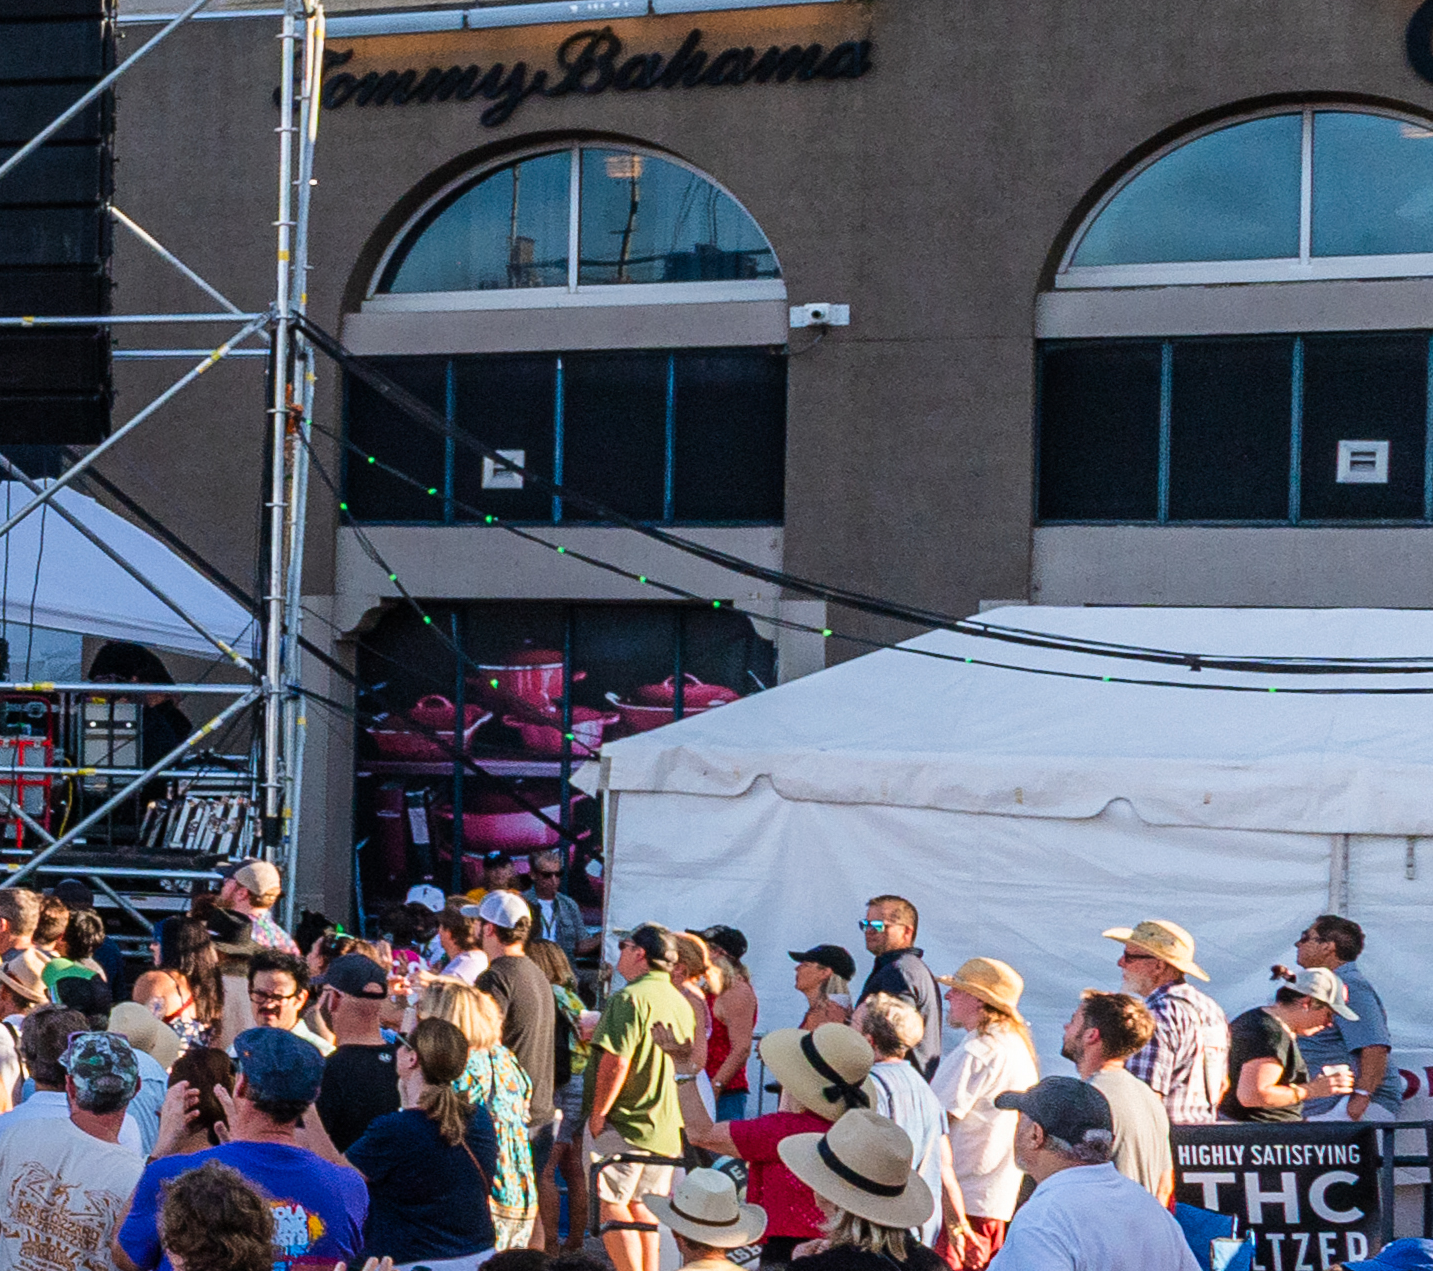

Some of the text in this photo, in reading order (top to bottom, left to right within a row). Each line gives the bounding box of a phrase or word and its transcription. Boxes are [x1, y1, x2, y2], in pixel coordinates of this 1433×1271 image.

[540, 27, 874, 98] Bahama
[1178, 1144, 1361, 1166] HIGHLY SATISFYING
[1182, 1170, 1365, 1224] THC
